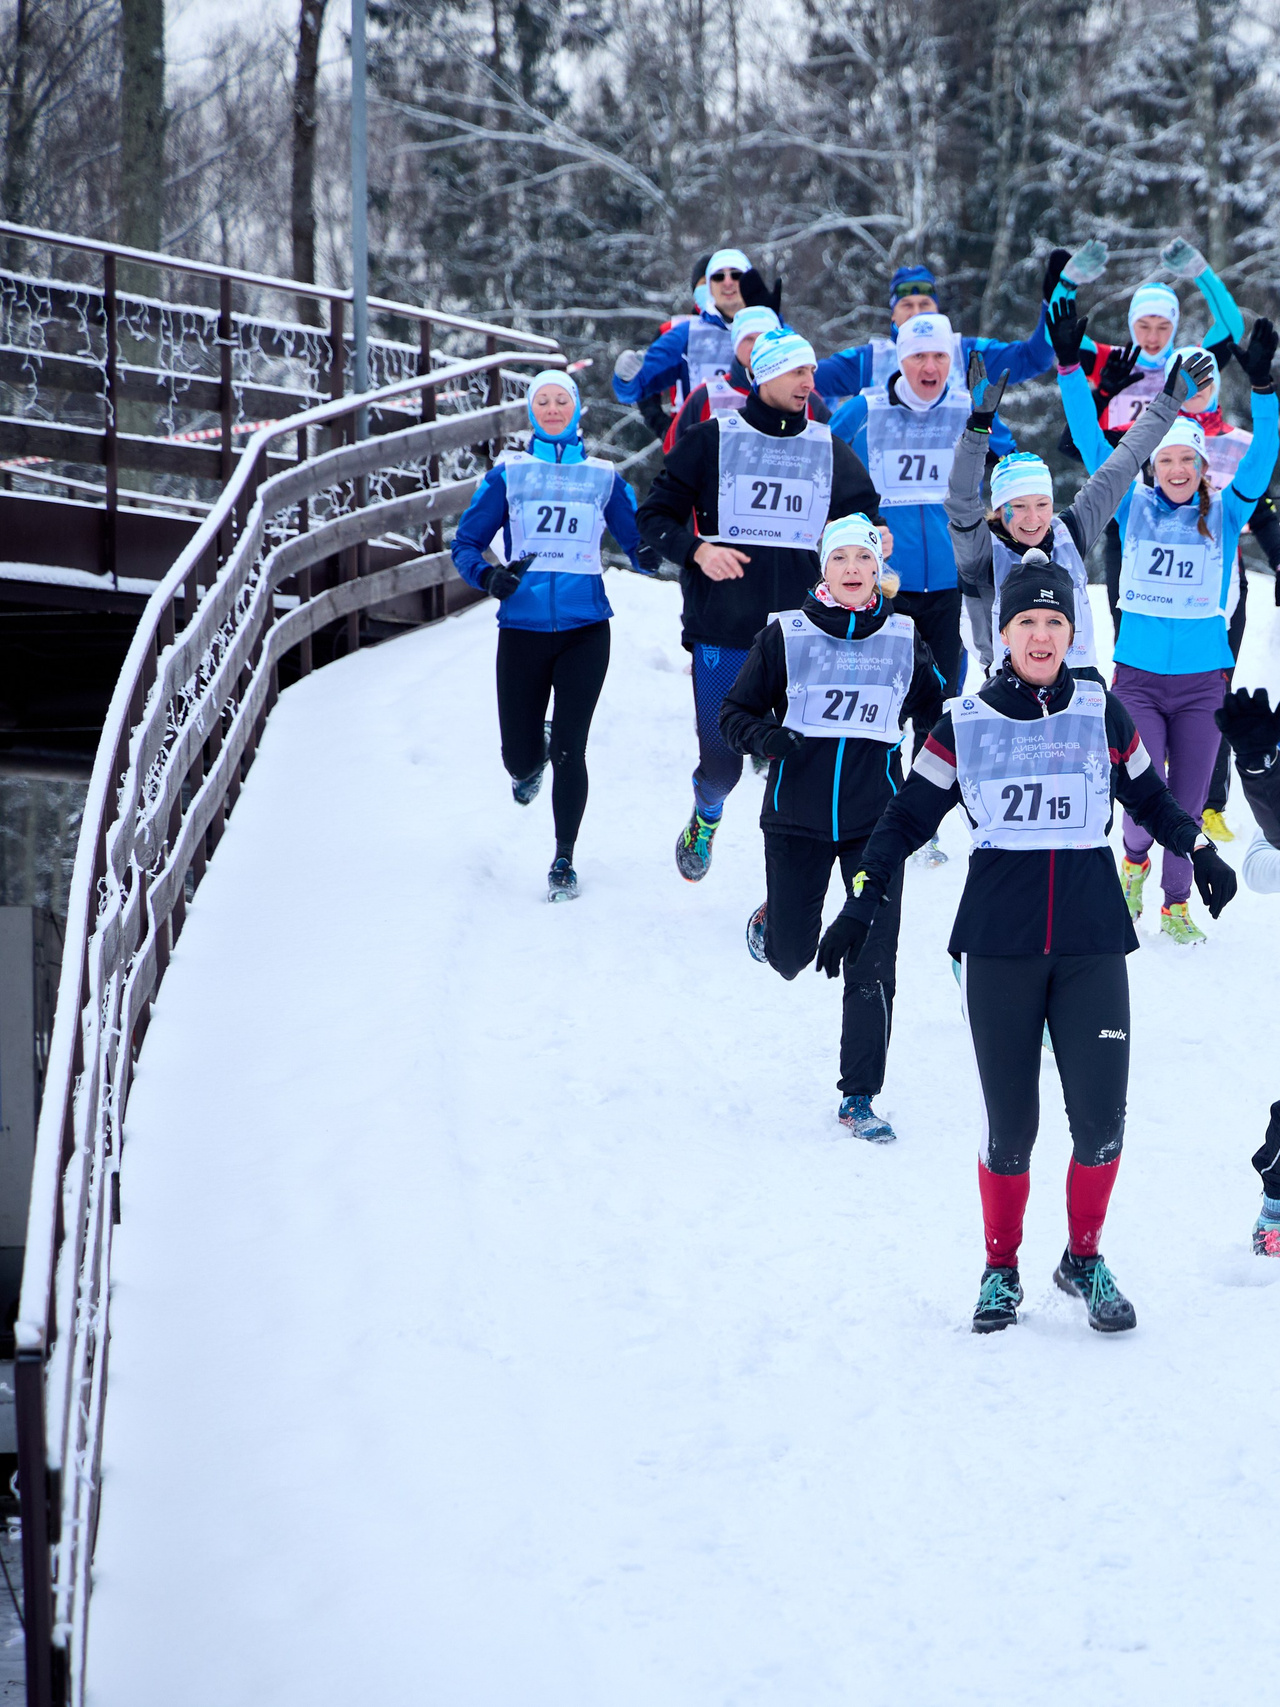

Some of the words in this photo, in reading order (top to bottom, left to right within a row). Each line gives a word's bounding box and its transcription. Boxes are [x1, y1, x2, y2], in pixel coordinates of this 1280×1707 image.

[898, 454, 926, 481] 27
[929, 464, 939, 481] 4
[750, 481, 782, 510] 27
[784, 495, 803, 513] 10
[536, 506, 566, 533] 27
[568, 518, 578, 534] 8
[740, 528, 782, 538] РОСАТОМ
[1148, 547, 1174, 577] 27
[1176, 561, 1194, 578] 12
[1135, 594, 1173, 604] РОСАТОМ
[836, 656, 894, 665] ДИВИЗИОНОВ
[822, 689, 859, 721] 27
[859, 703, 879, 723] 19
[1011, 734, 1045, 745] ГОНКА
[1011, 742, 1080, 753] ДИВИЗИОНОВ
[1012, 751, 1066, 761] РОСАТОМА
[1001, 783, 1043, 822] 27
[1046, 796, 1071, 820] 15
